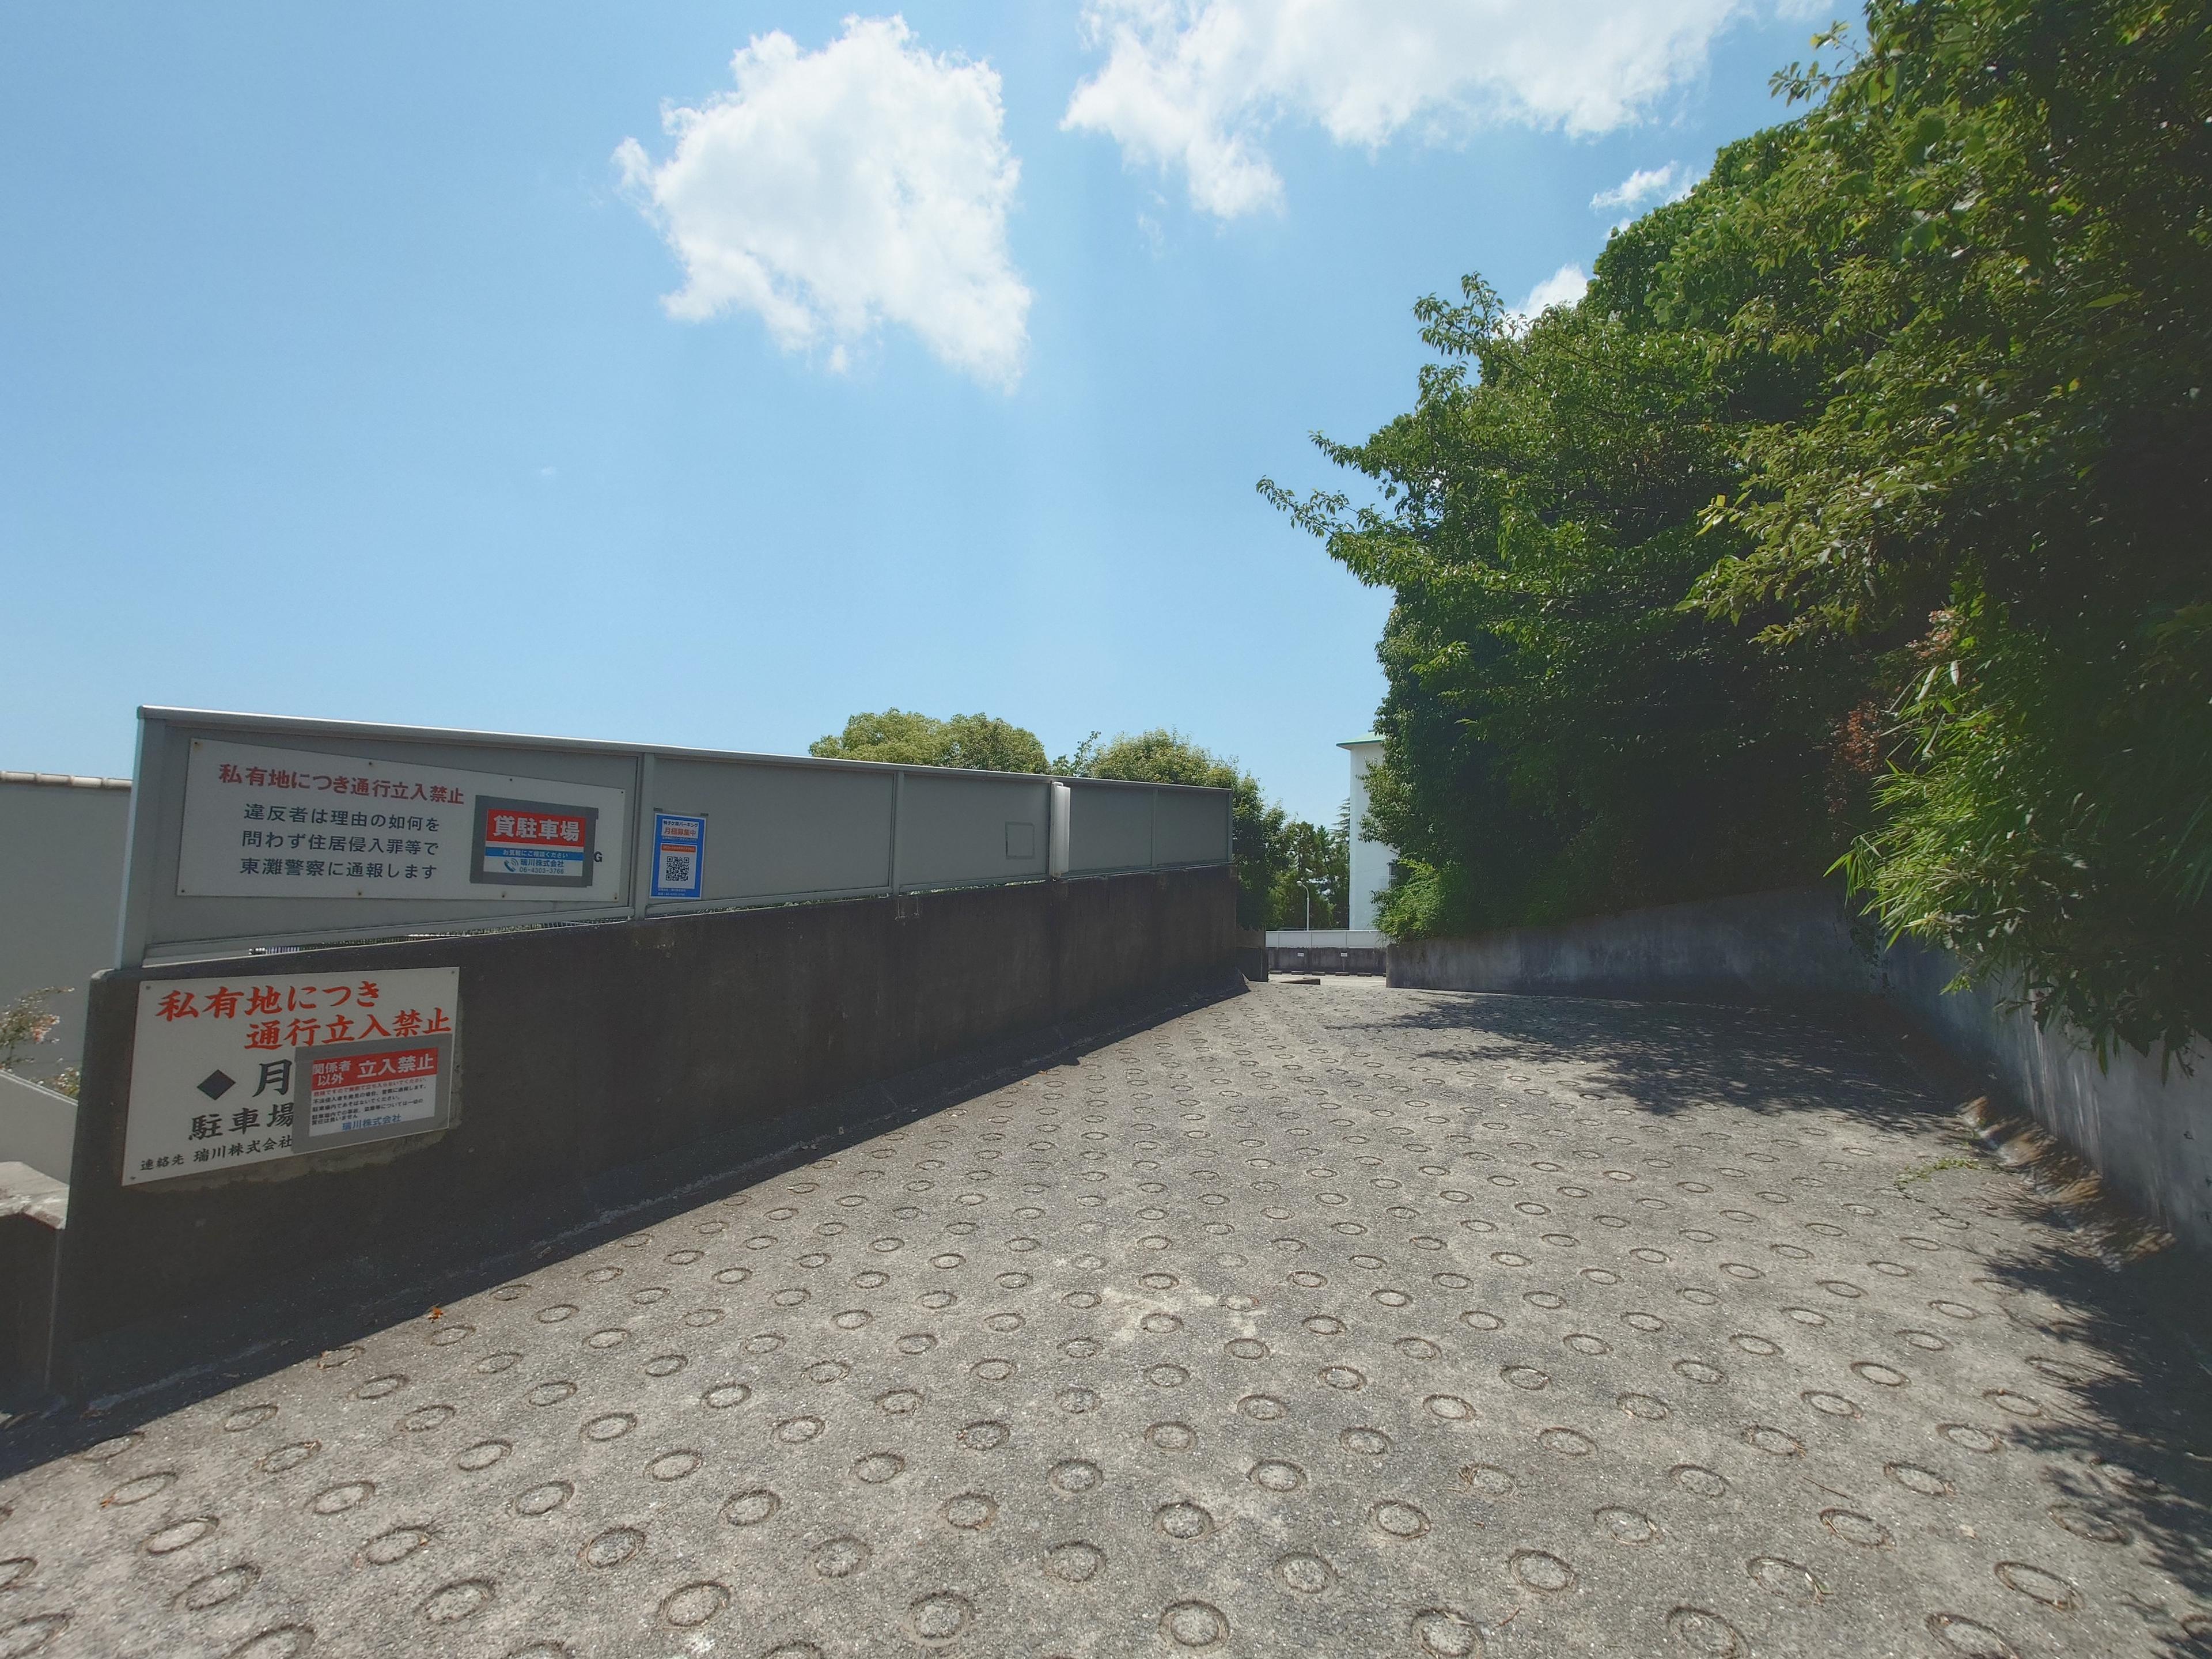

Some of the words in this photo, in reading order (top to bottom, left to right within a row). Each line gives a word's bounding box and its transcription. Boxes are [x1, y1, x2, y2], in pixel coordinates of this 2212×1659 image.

[219, 764, 464, 805] 私有地につき通行立入禁止
[244, 803, 440, 832] 違反者は理由の如何を
[493, 815, 580, 842] 貸駐車場
[242, 831, 438, 855] 問わず住居侵入罪等で
[594, 851, 603, 862] G
[240, 857, 437, 879] 東灘警察に通報します
[156, 980, 380, 1022] 私有地につき
[244, 1007, 452, 1050] 通行立入禁止
[252, 1059, 292, 1097] 月
[313, 1060, 351, 1074] 関係者
[318, 1073, 344, 1086] 以外
[357, 1054, 434, 1078] 立入禁止
[188, 1102, 294, 1141] 駐車場
[342, 1114, 402, 1131] 瑞川株式会社
[140, 1154, 184, 1171] 連絡先
[194, 1134, 293, 1162] 瑞川株式会社
